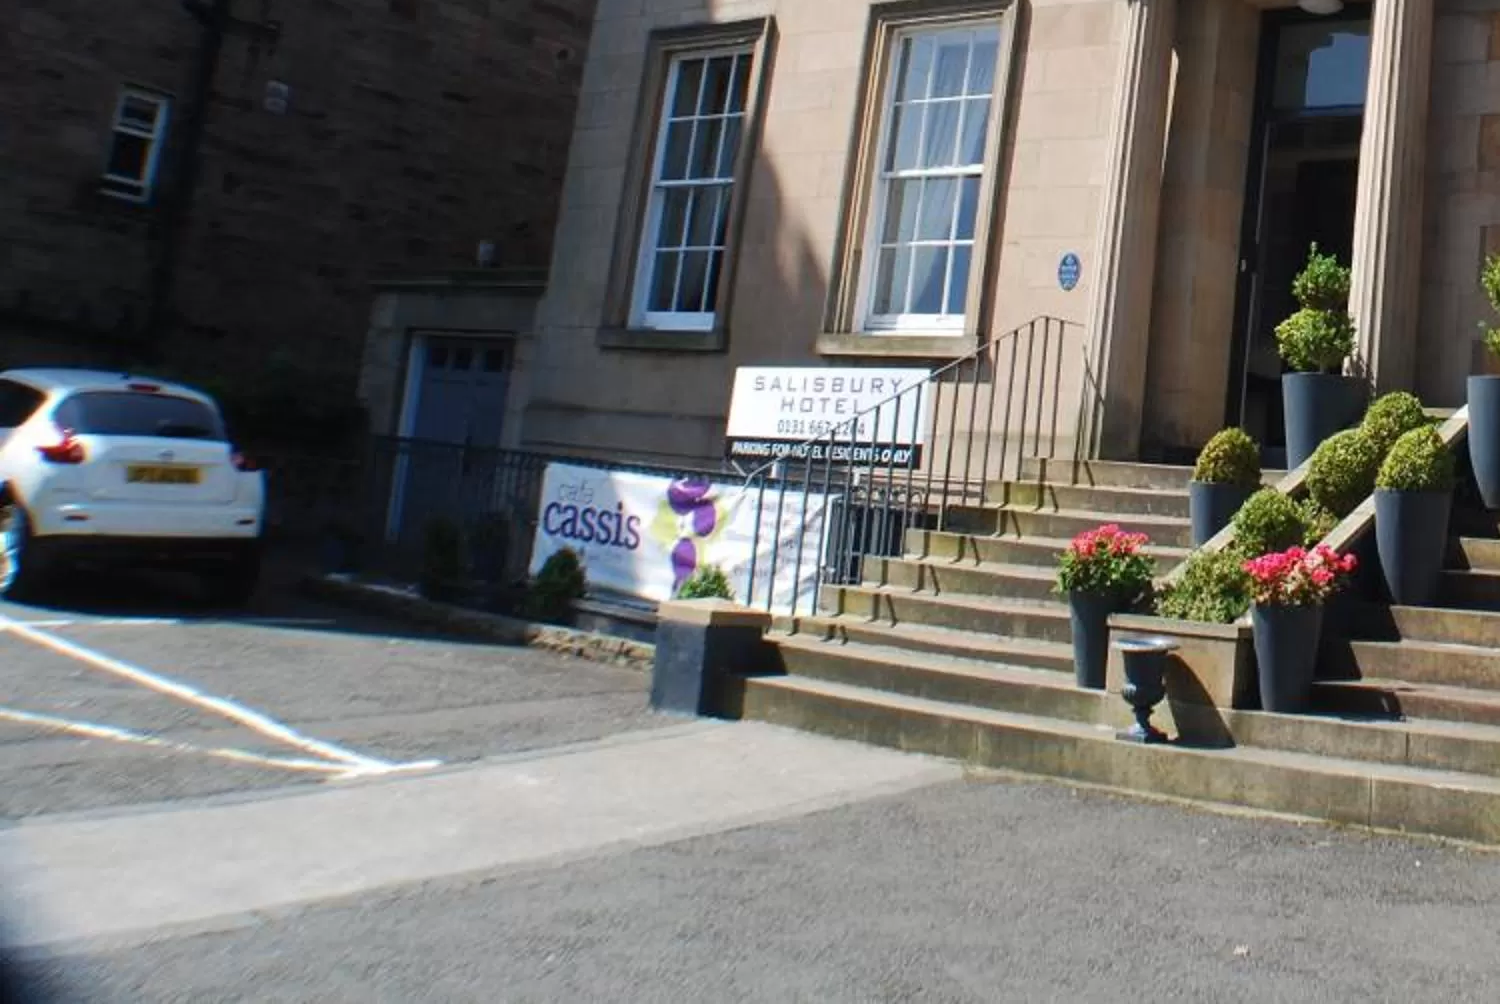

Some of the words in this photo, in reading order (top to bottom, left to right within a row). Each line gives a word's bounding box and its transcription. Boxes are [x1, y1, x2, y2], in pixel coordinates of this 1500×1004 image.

[754, 375, 903, 394] SALISBURY
[780, 397, 864, 415] HOTEL
[777, 419, 804, 434] 0131
[835, 422, 865, 436] 124
[732, 441, 770, 457] PARKING
[771, 443, 791, 457] FOR
[543, 501, 641, 550] cassis
